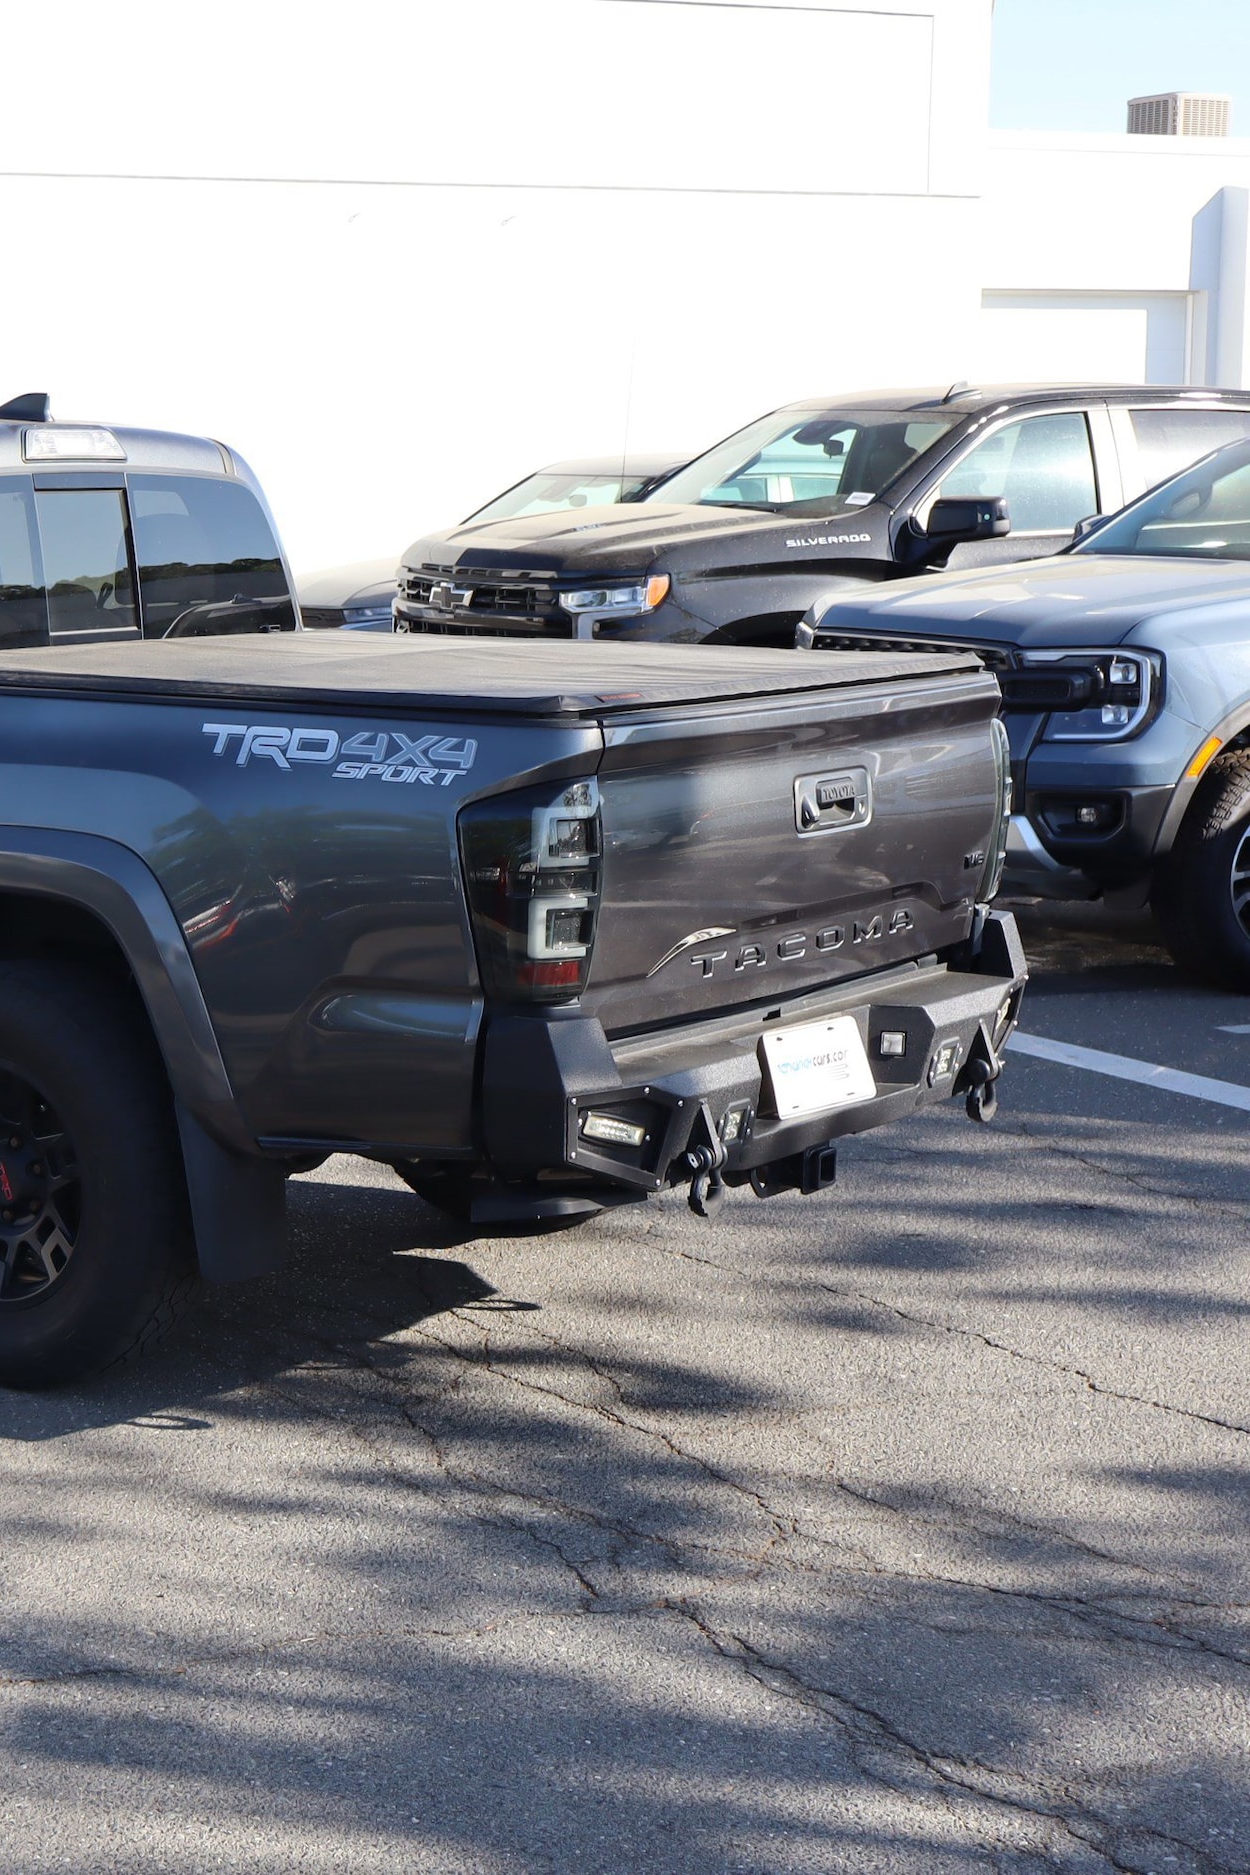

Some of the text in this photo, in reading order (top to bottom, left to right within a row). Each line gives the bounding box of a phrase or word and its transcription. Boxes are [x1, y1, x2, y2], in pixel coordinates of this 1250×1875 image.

[786, 533, 871, 548] SILVERADO
[201, 723, 340, 771] TRD
[332, 761, 468, 786] SPORT
[822, 784, 856, 801] TOYOTA
[691, 907, 915, 979] TACOMA
